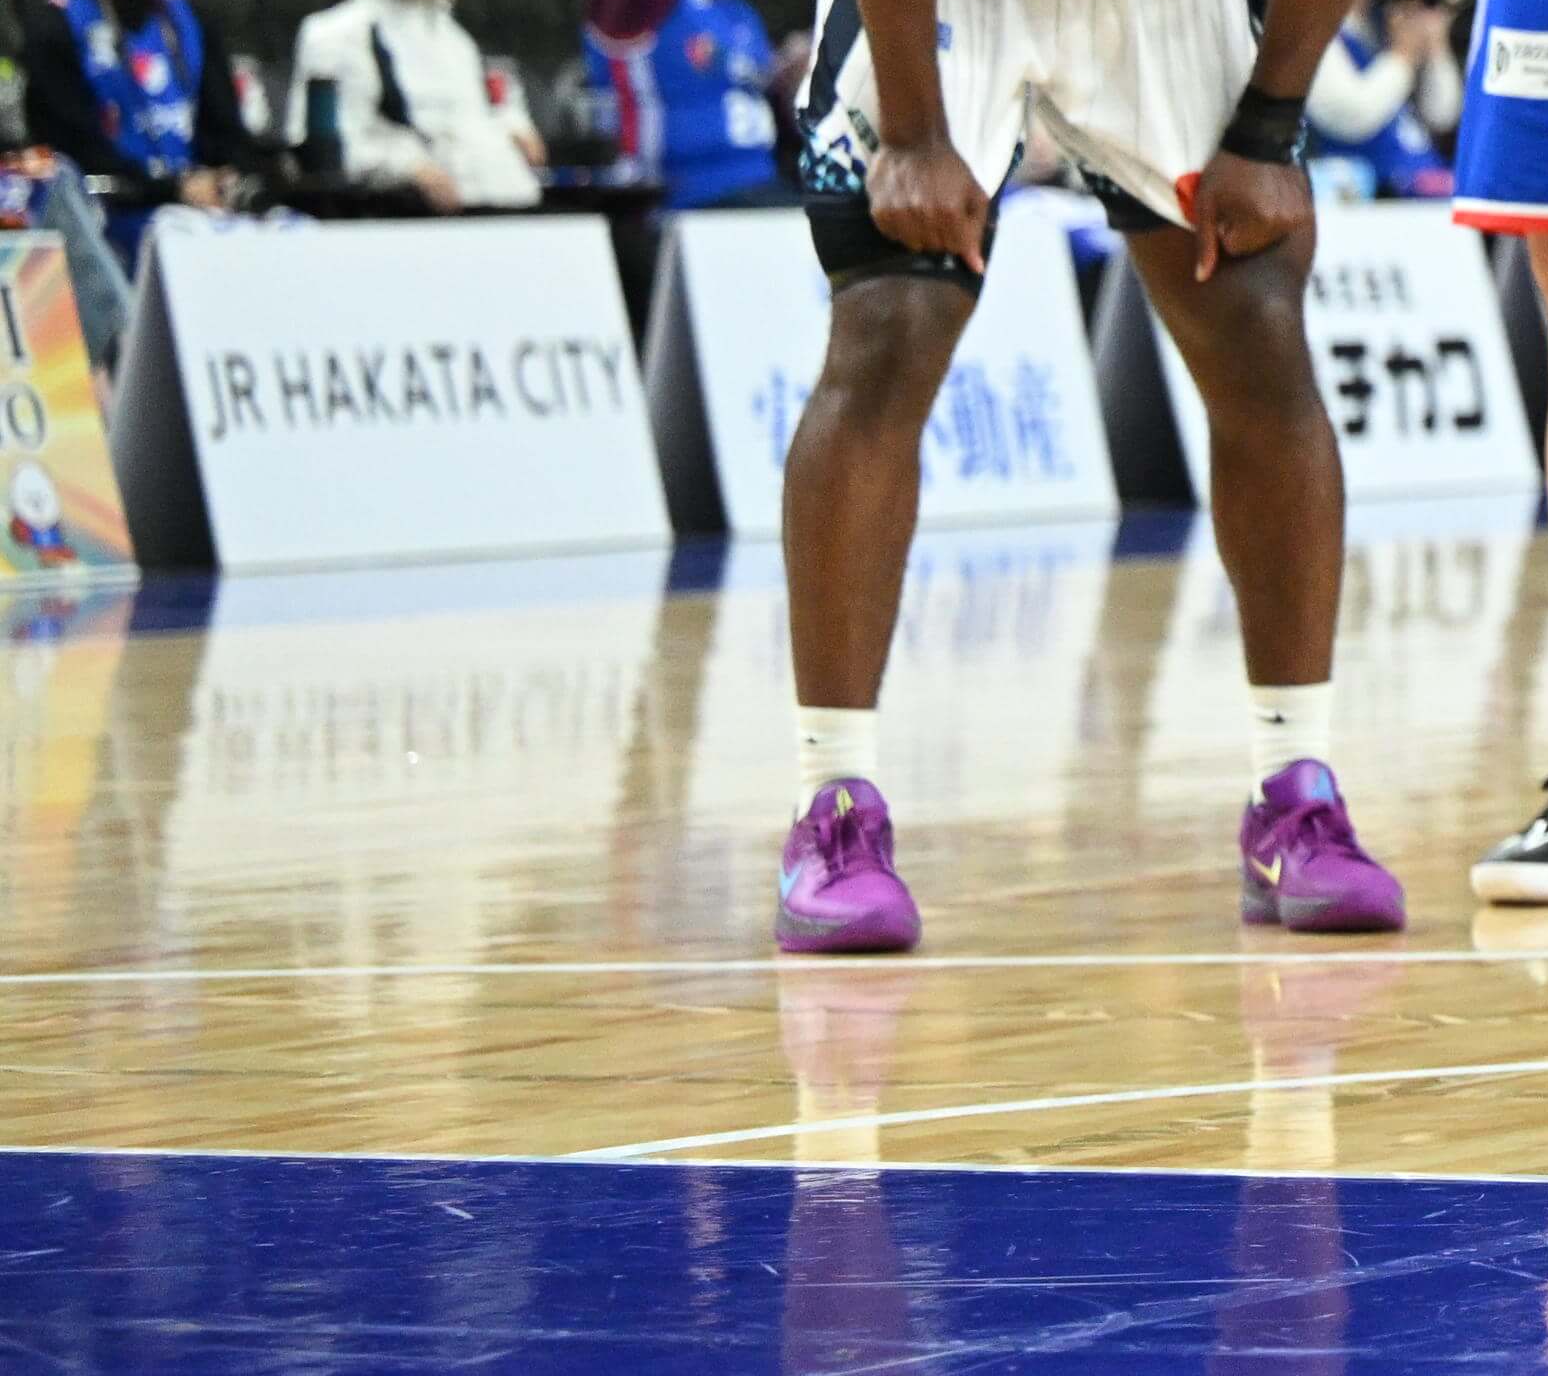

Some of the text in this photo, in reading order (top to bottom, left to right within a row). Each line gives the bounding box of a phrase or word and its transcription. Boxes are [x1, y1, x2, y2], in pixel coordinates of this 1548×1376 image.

[205, 335, 626, 442] JR HAKATA CITY
